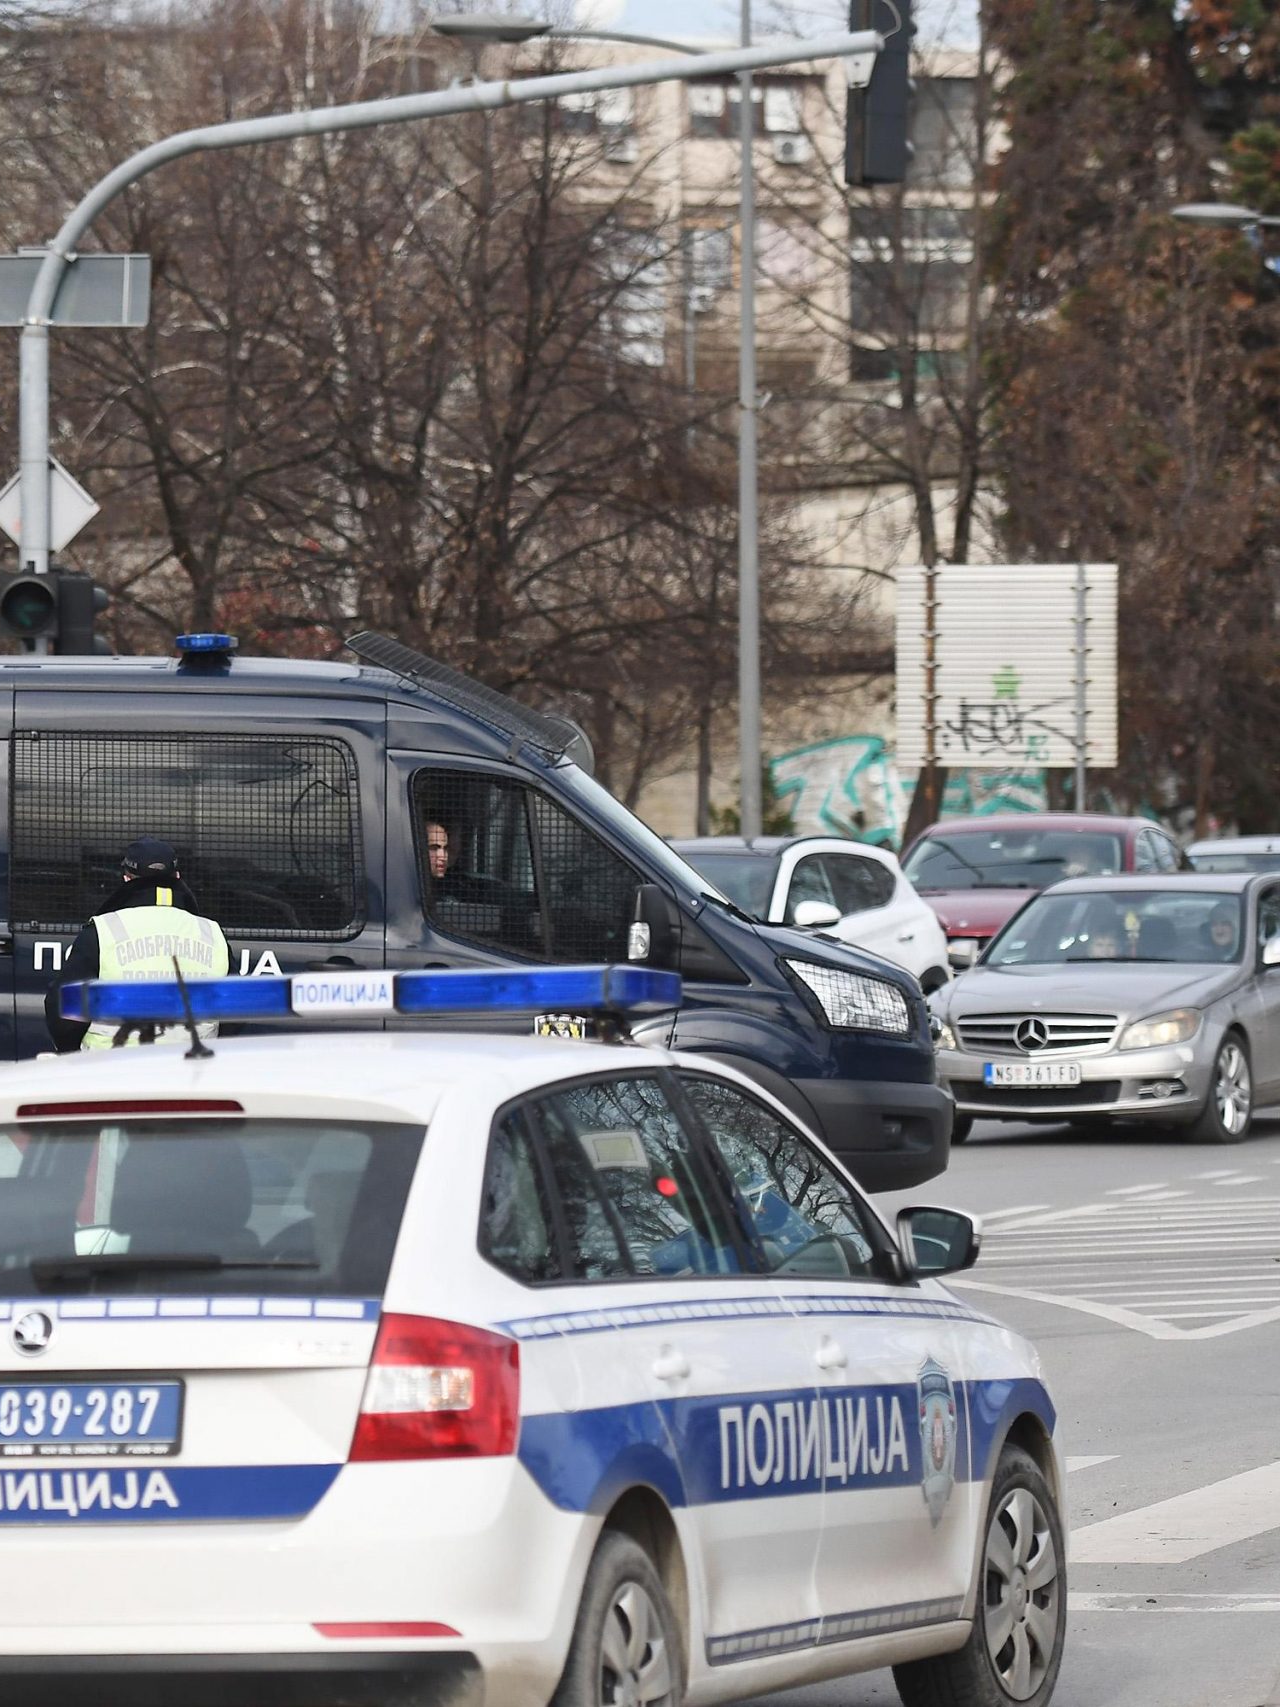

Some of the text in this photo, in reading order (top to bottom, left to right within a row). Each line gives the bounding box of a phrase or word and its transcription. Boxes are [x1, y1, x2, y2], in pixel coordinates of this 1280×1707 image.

[116, 934, 213, 968] САОБРАЋАЈНА
[294, 983, 389, 1005] ПОЛИЦИЈА
[718, 1396, 909, 1489] ПОЛИЦИЈА
